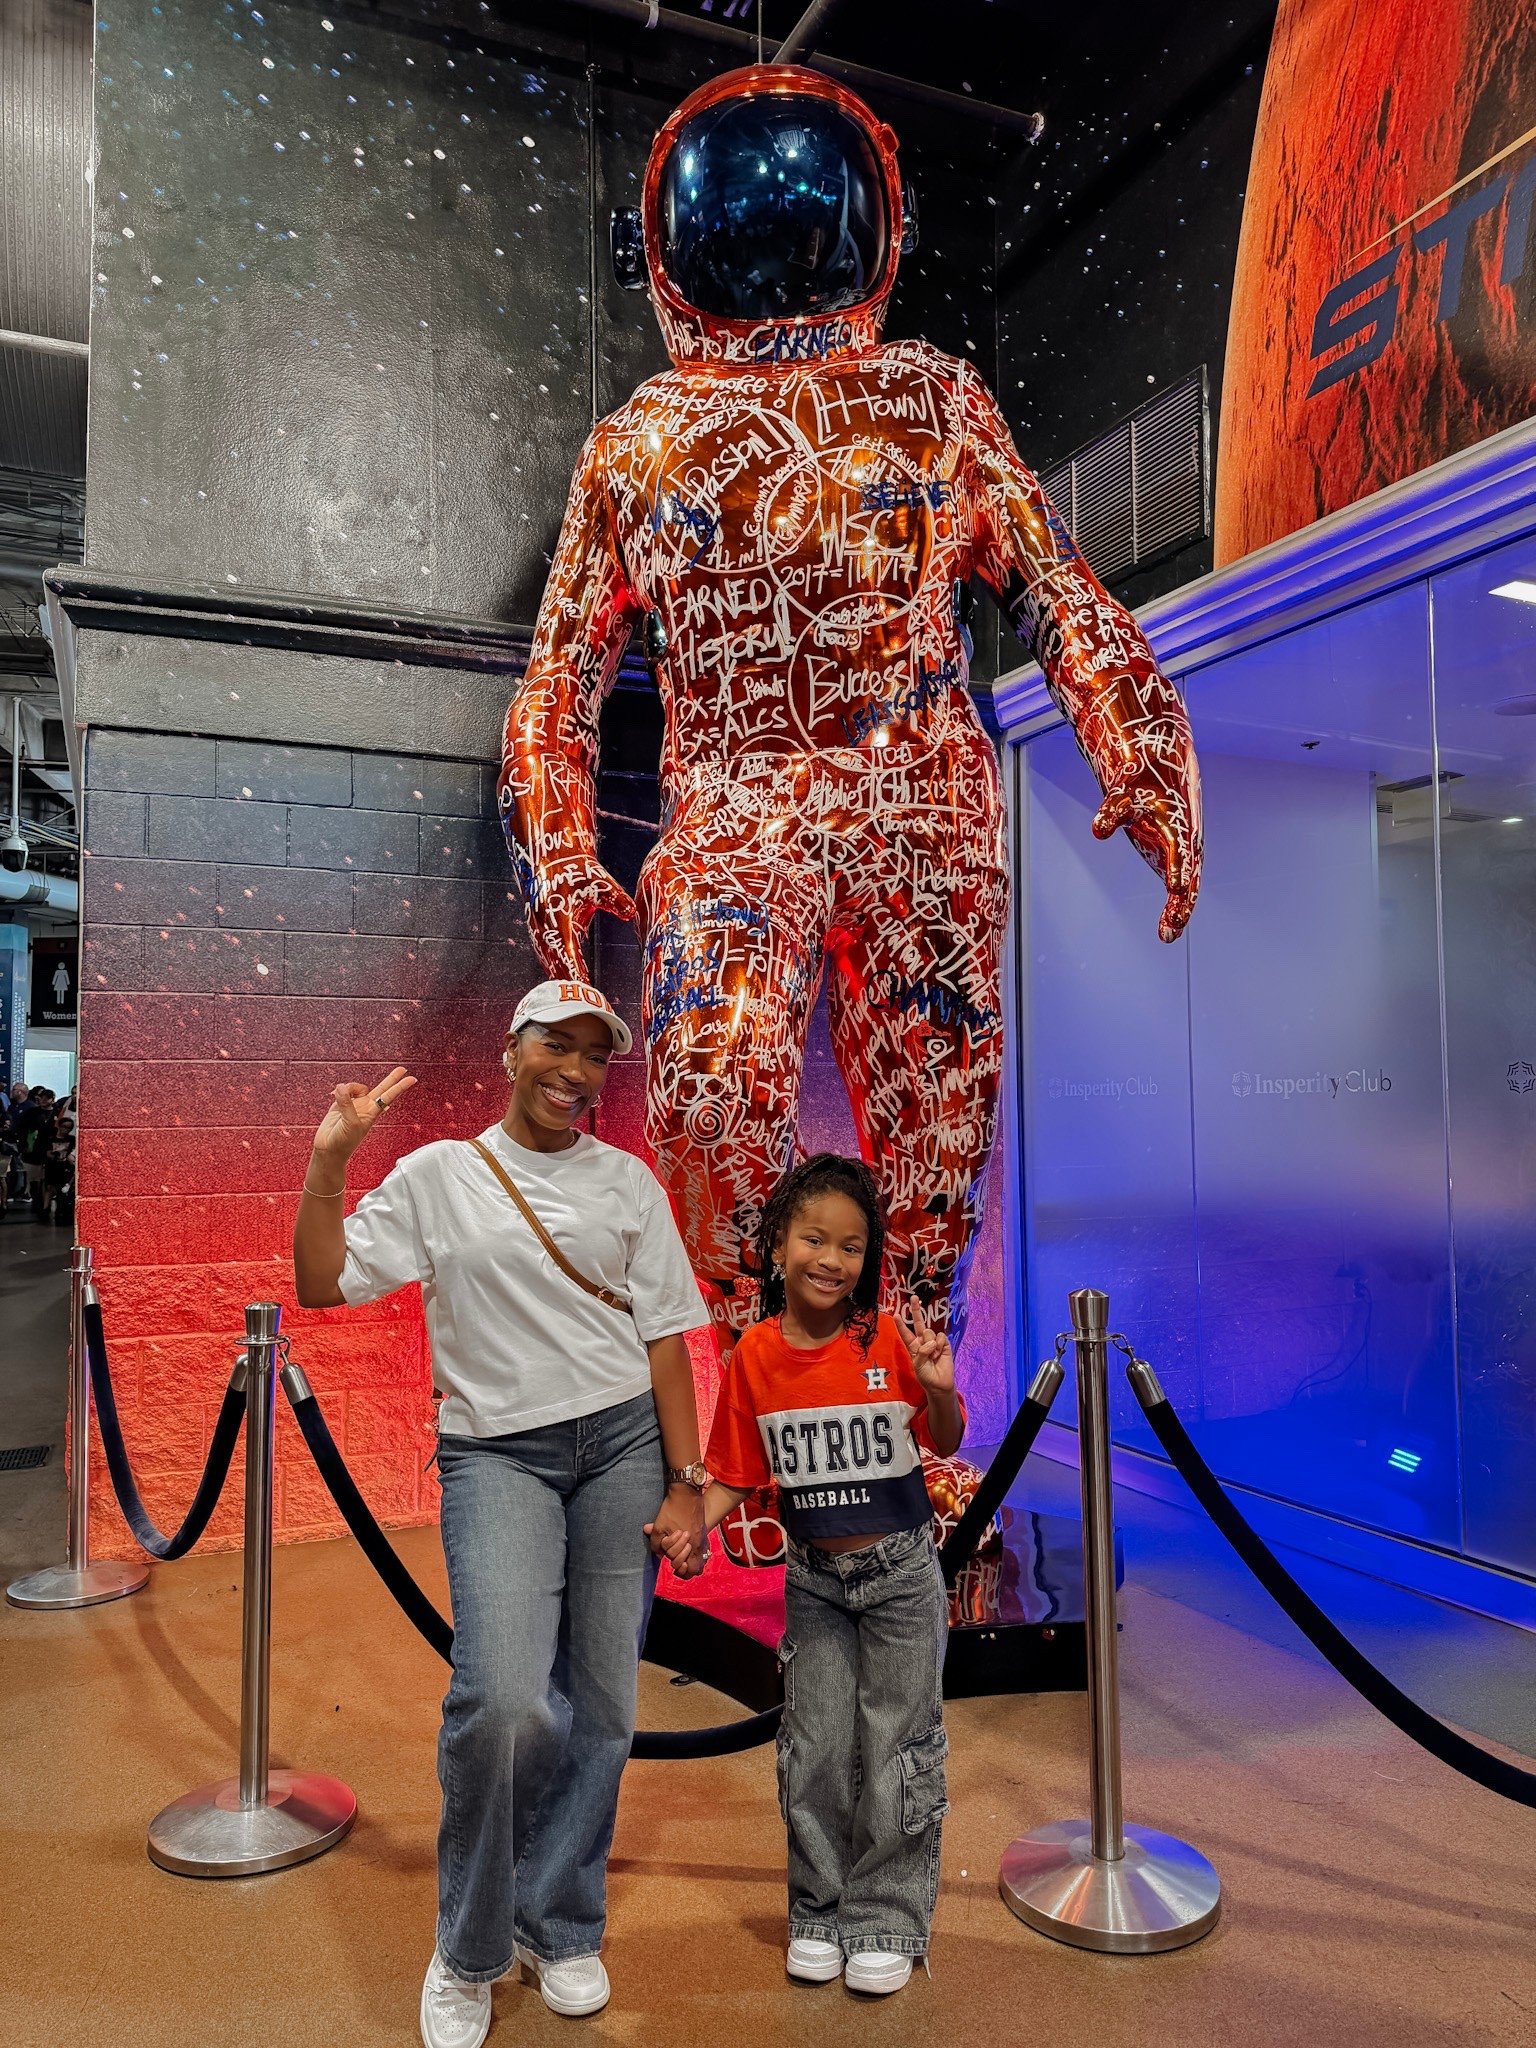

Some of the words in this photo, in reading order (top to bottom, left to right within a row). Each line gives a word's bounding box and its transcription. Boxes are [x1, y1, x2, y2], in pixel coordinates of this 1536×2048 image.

[1064, 1078, 1124, 1101] Insperity
[1125, 1075, 1159, 1096] Club
[1254, 1072, 1342, 1100] Insperity
[1344, 1068, 1393, 1093] Club
[865, 1368, 889, 1391] H
[766, 1411, 896, 1478] ASTROS
[793, 1487, 872, 1511] BASEBALL
